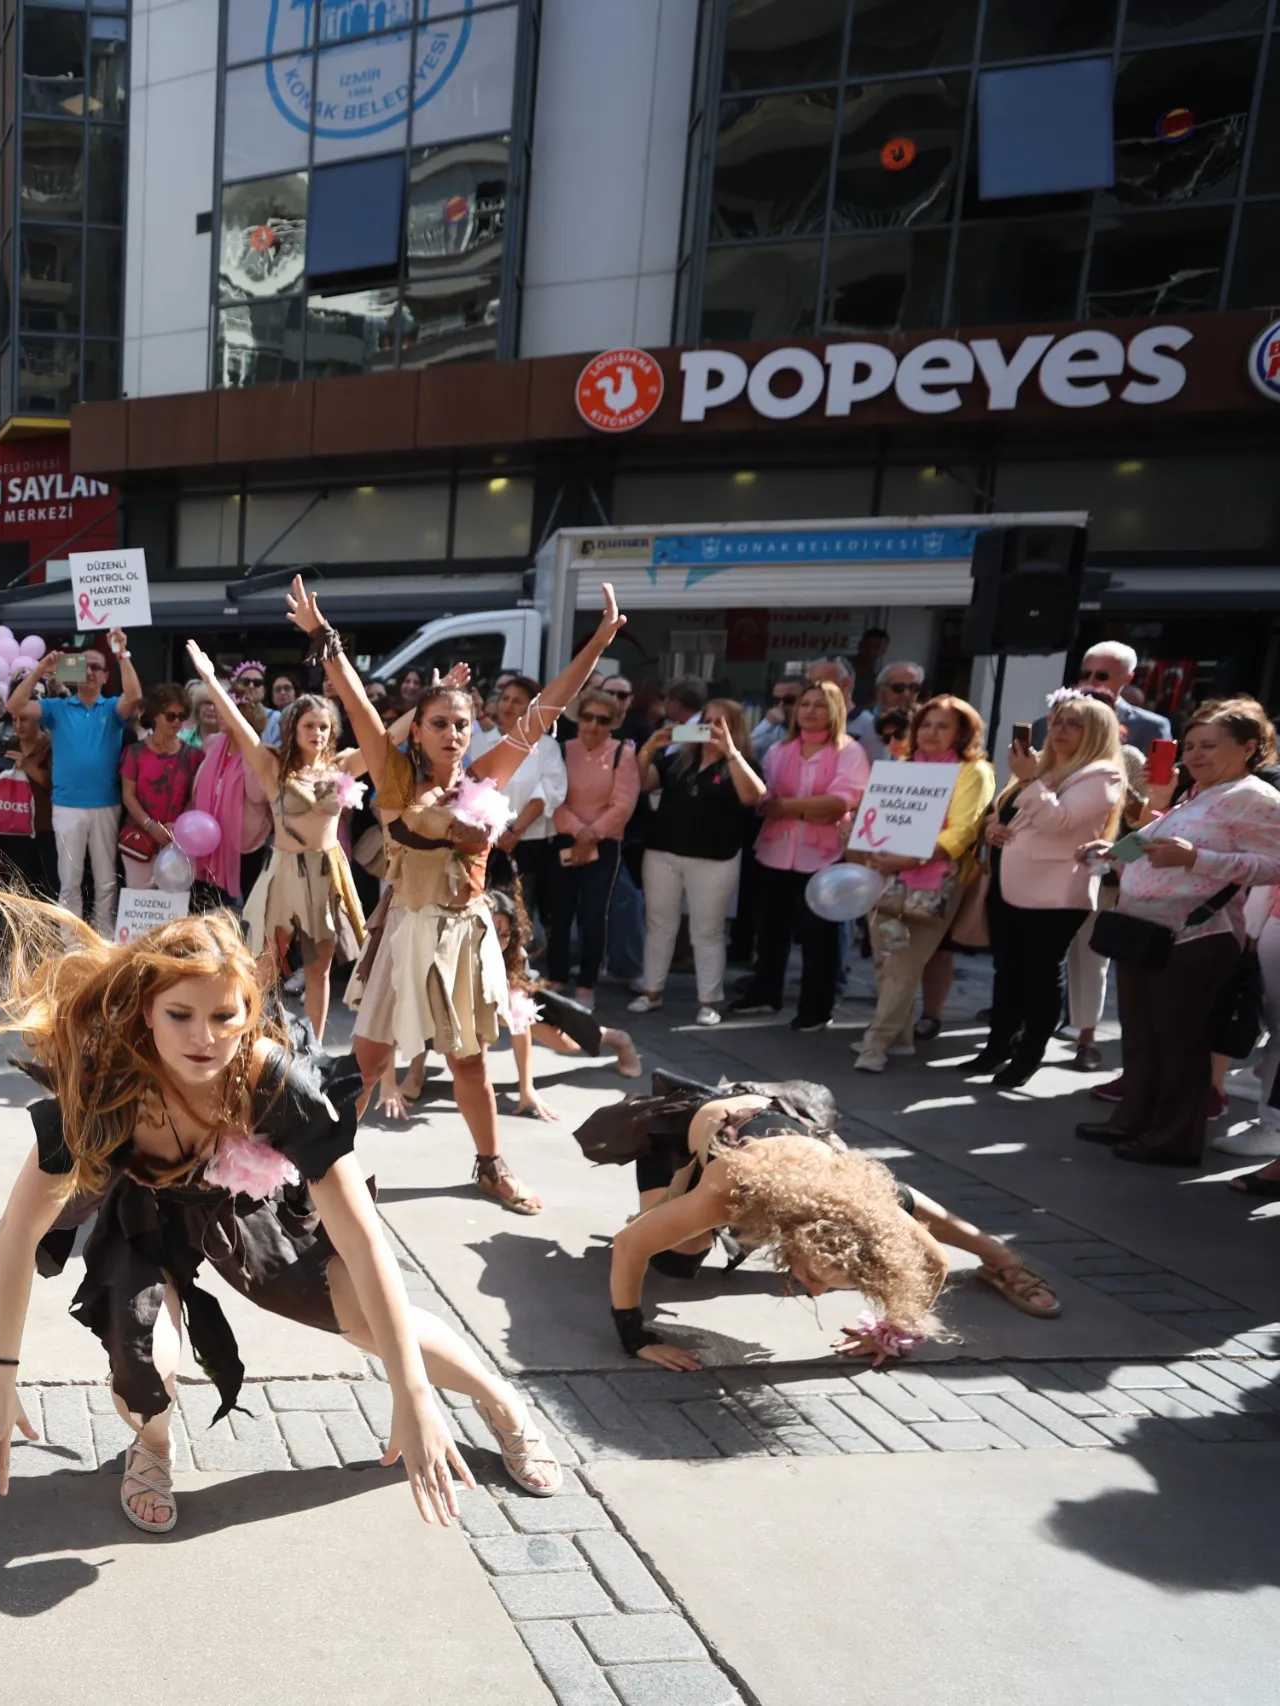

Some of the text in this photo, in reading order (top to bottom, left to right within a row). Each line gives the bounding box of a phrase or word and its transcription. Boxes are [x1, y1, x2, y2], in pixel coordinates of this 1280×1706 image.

[7, 473, 110, 504] SAYLAN
[4, 502, 73, 524] MERKEZİ
[724, 537, 918, 554] KONAK BELEDİYESİ
[87, 558, 127, 571] DÜZENLİ
[79, 572, 140, 584] KONTROL OL
[89, 585, 132, 595] HAYATINI
[93, 597, 131, 607] KURTAR
[869, 784, 949, 797] ERKEN FARKET
[885, 814, 912, 826] YAŞA
[124, 909, 165, 921] KONTROL
